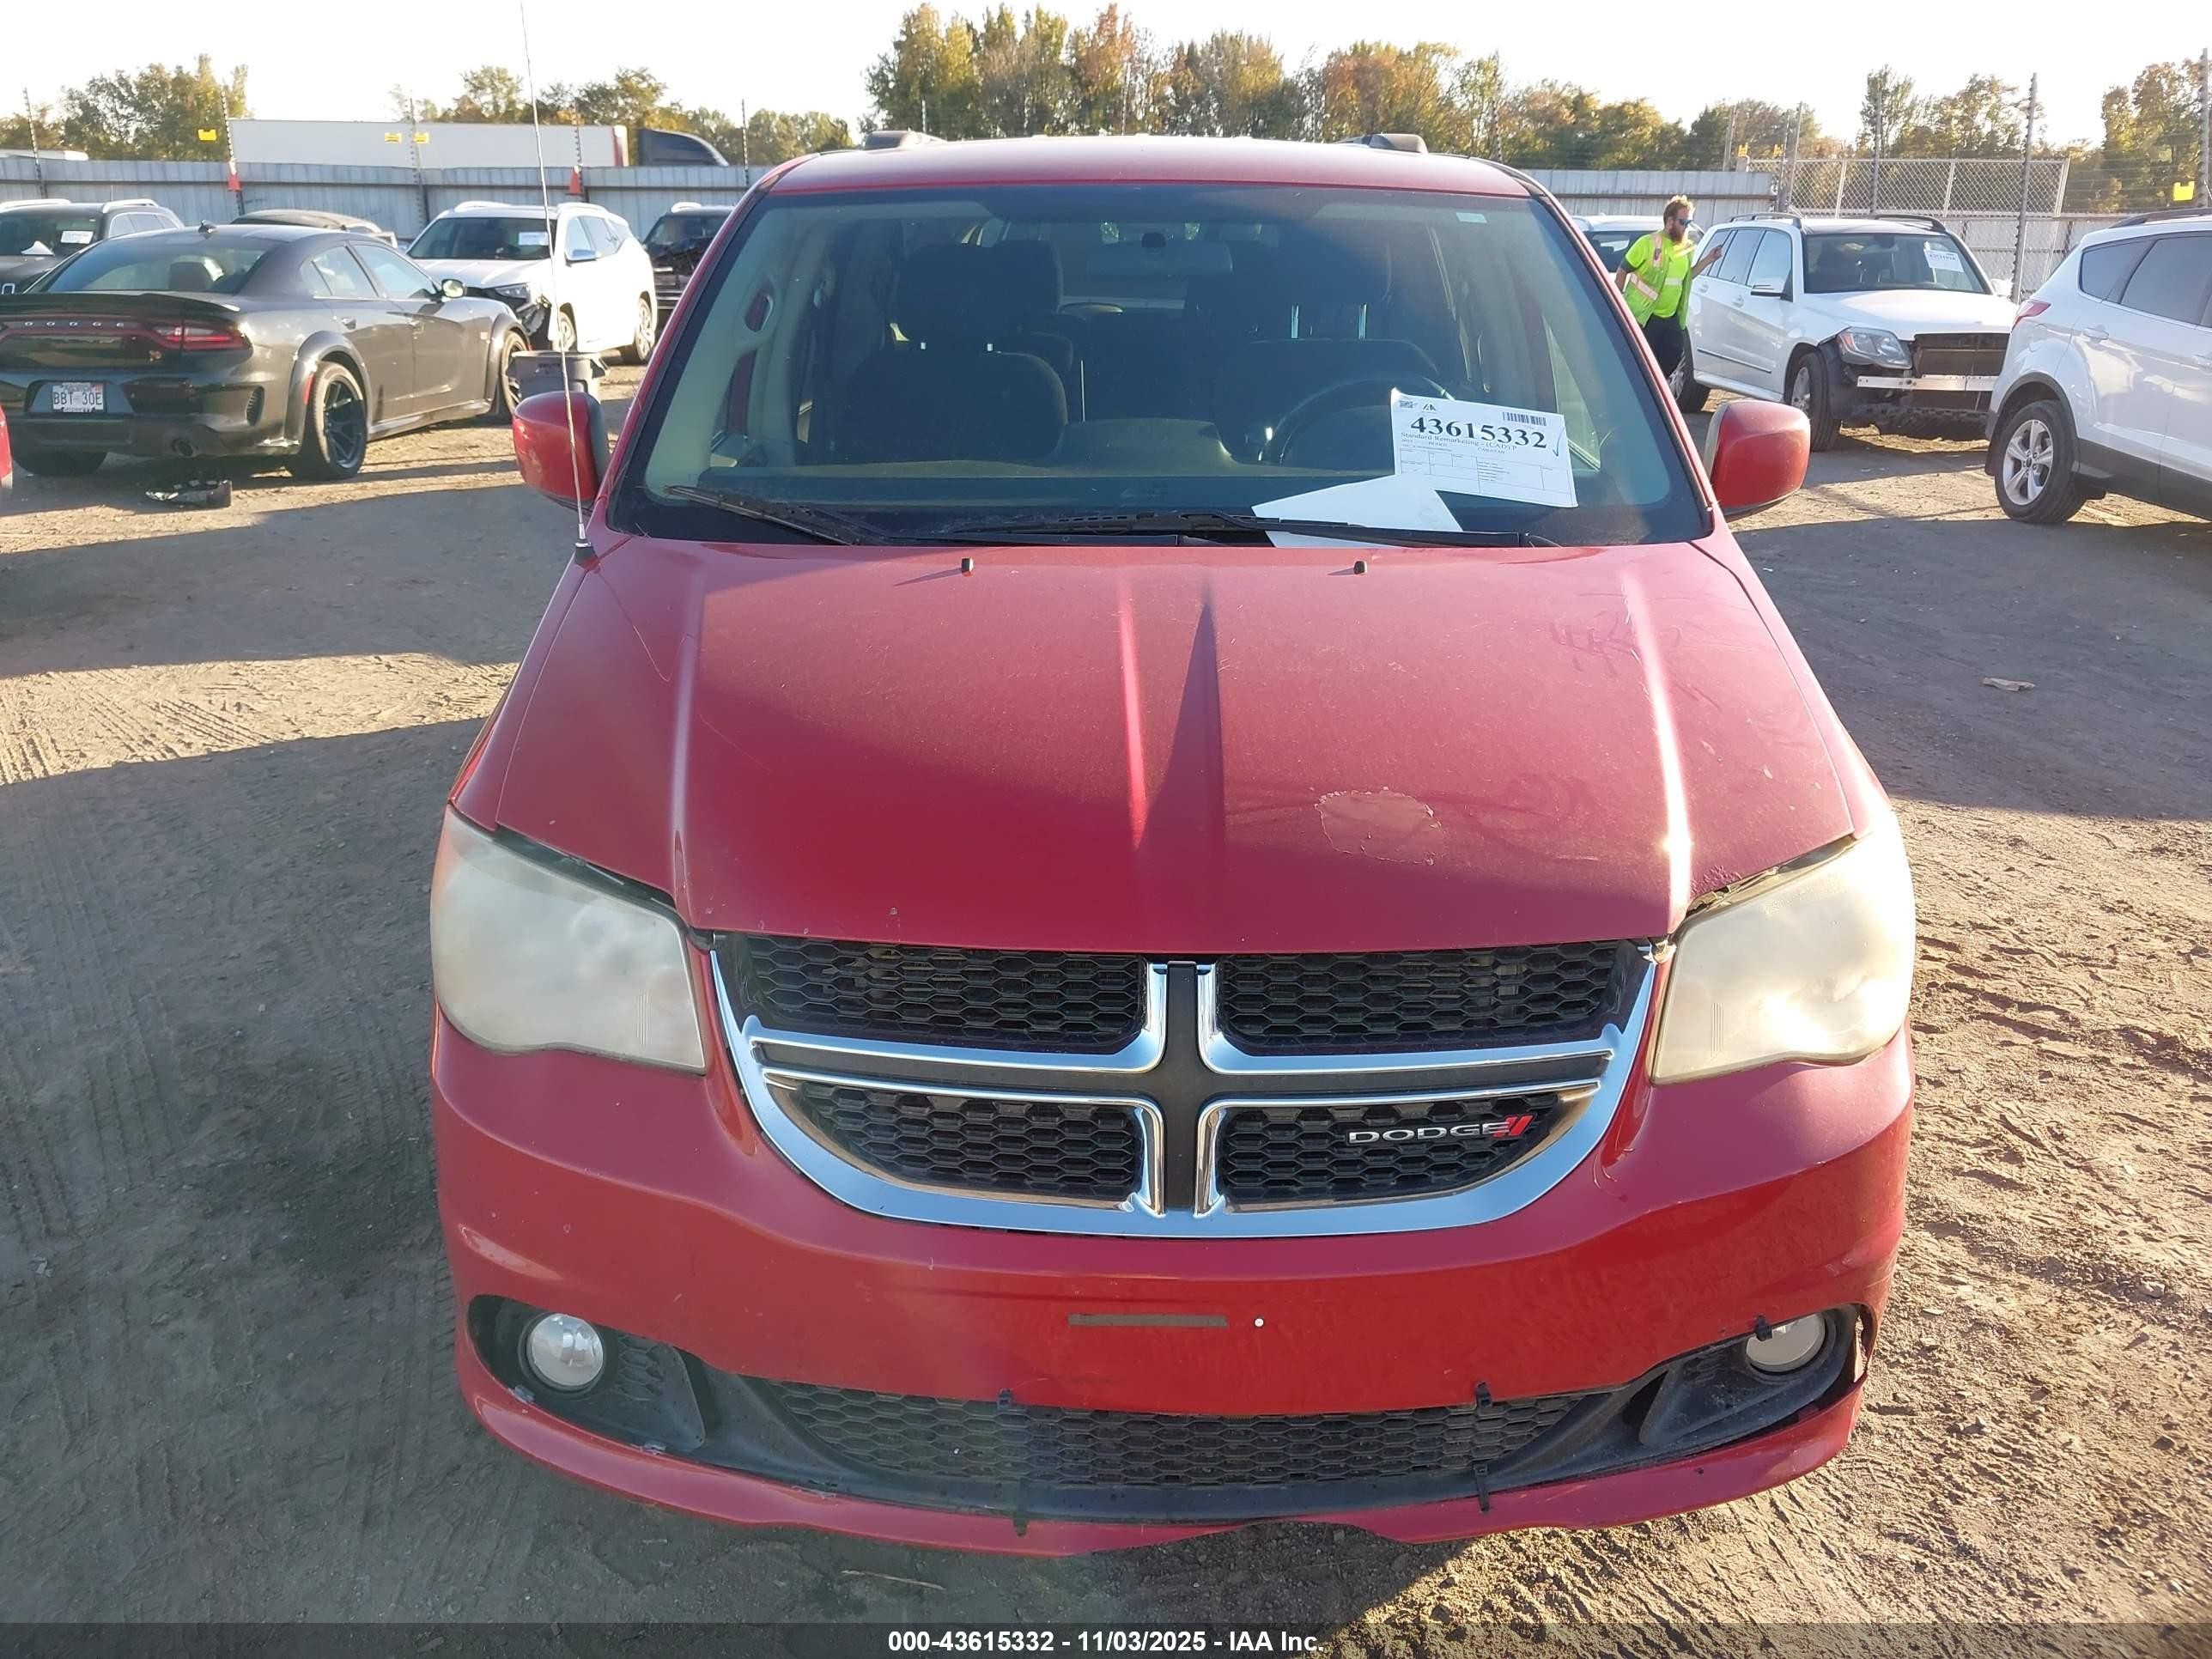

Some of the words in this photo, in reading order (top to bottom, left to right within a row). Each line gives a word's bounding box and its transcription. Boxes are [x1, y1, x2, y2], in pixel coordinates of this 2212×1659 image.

[53, 392, 73, 405] BBT
[82, 392, 102, 405] 30E
[1401, 432, 1432, 441] Standard
[1434, 435, 1480, 446] Remarketing
[1411, 416, 1547, 449] 43615332
[1349, 1121, 1510, 1144] DODGE
